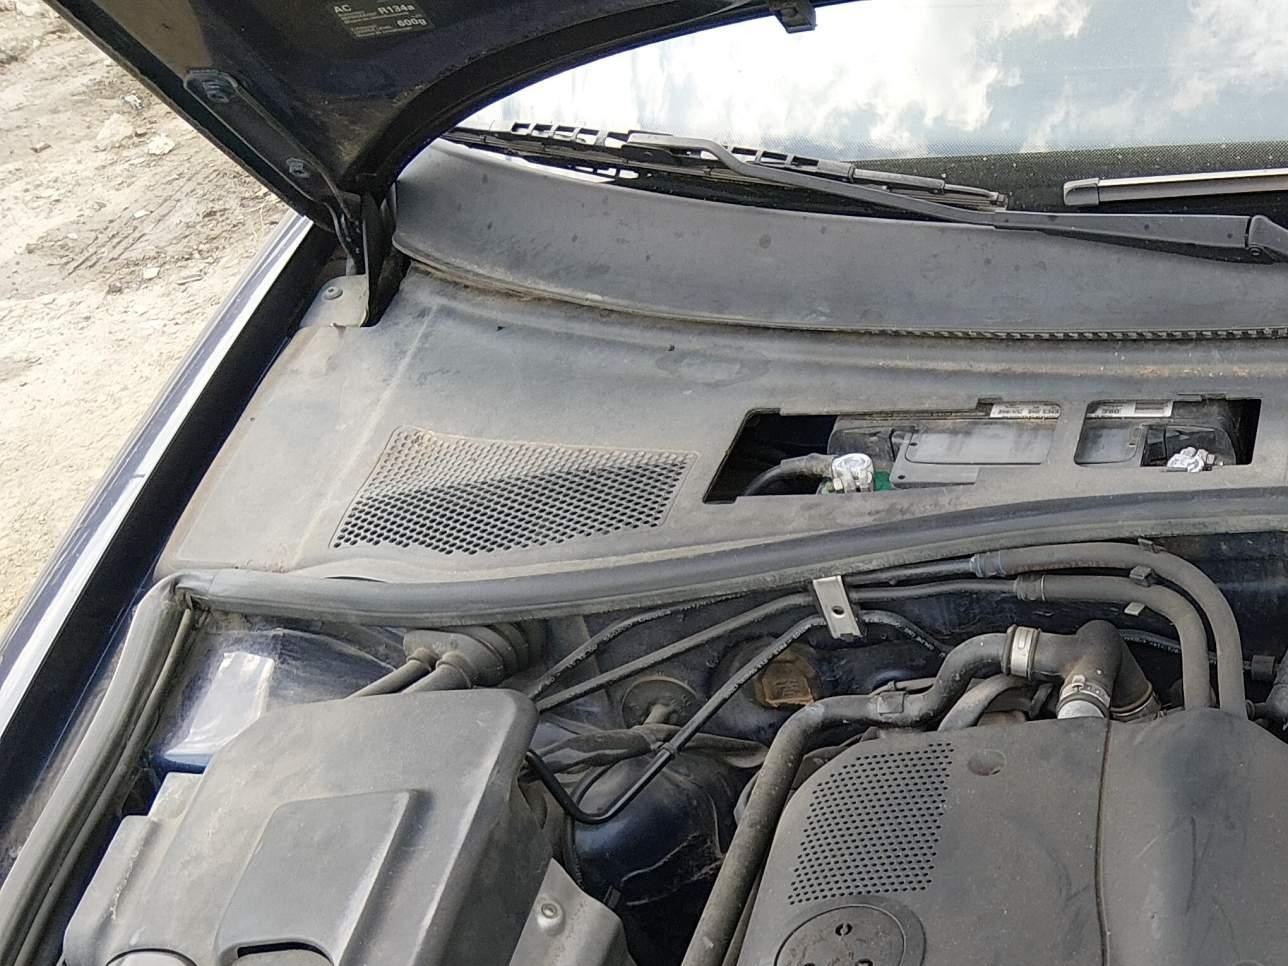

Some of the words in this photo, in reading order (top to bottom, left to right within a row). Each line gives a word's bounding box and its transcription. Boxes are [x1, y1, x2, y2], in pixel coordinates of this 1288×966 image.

[333, 4, 352, 13] AC
[377, 4, 415, 14] R134a
[397, 18, 428, 27] 600g
